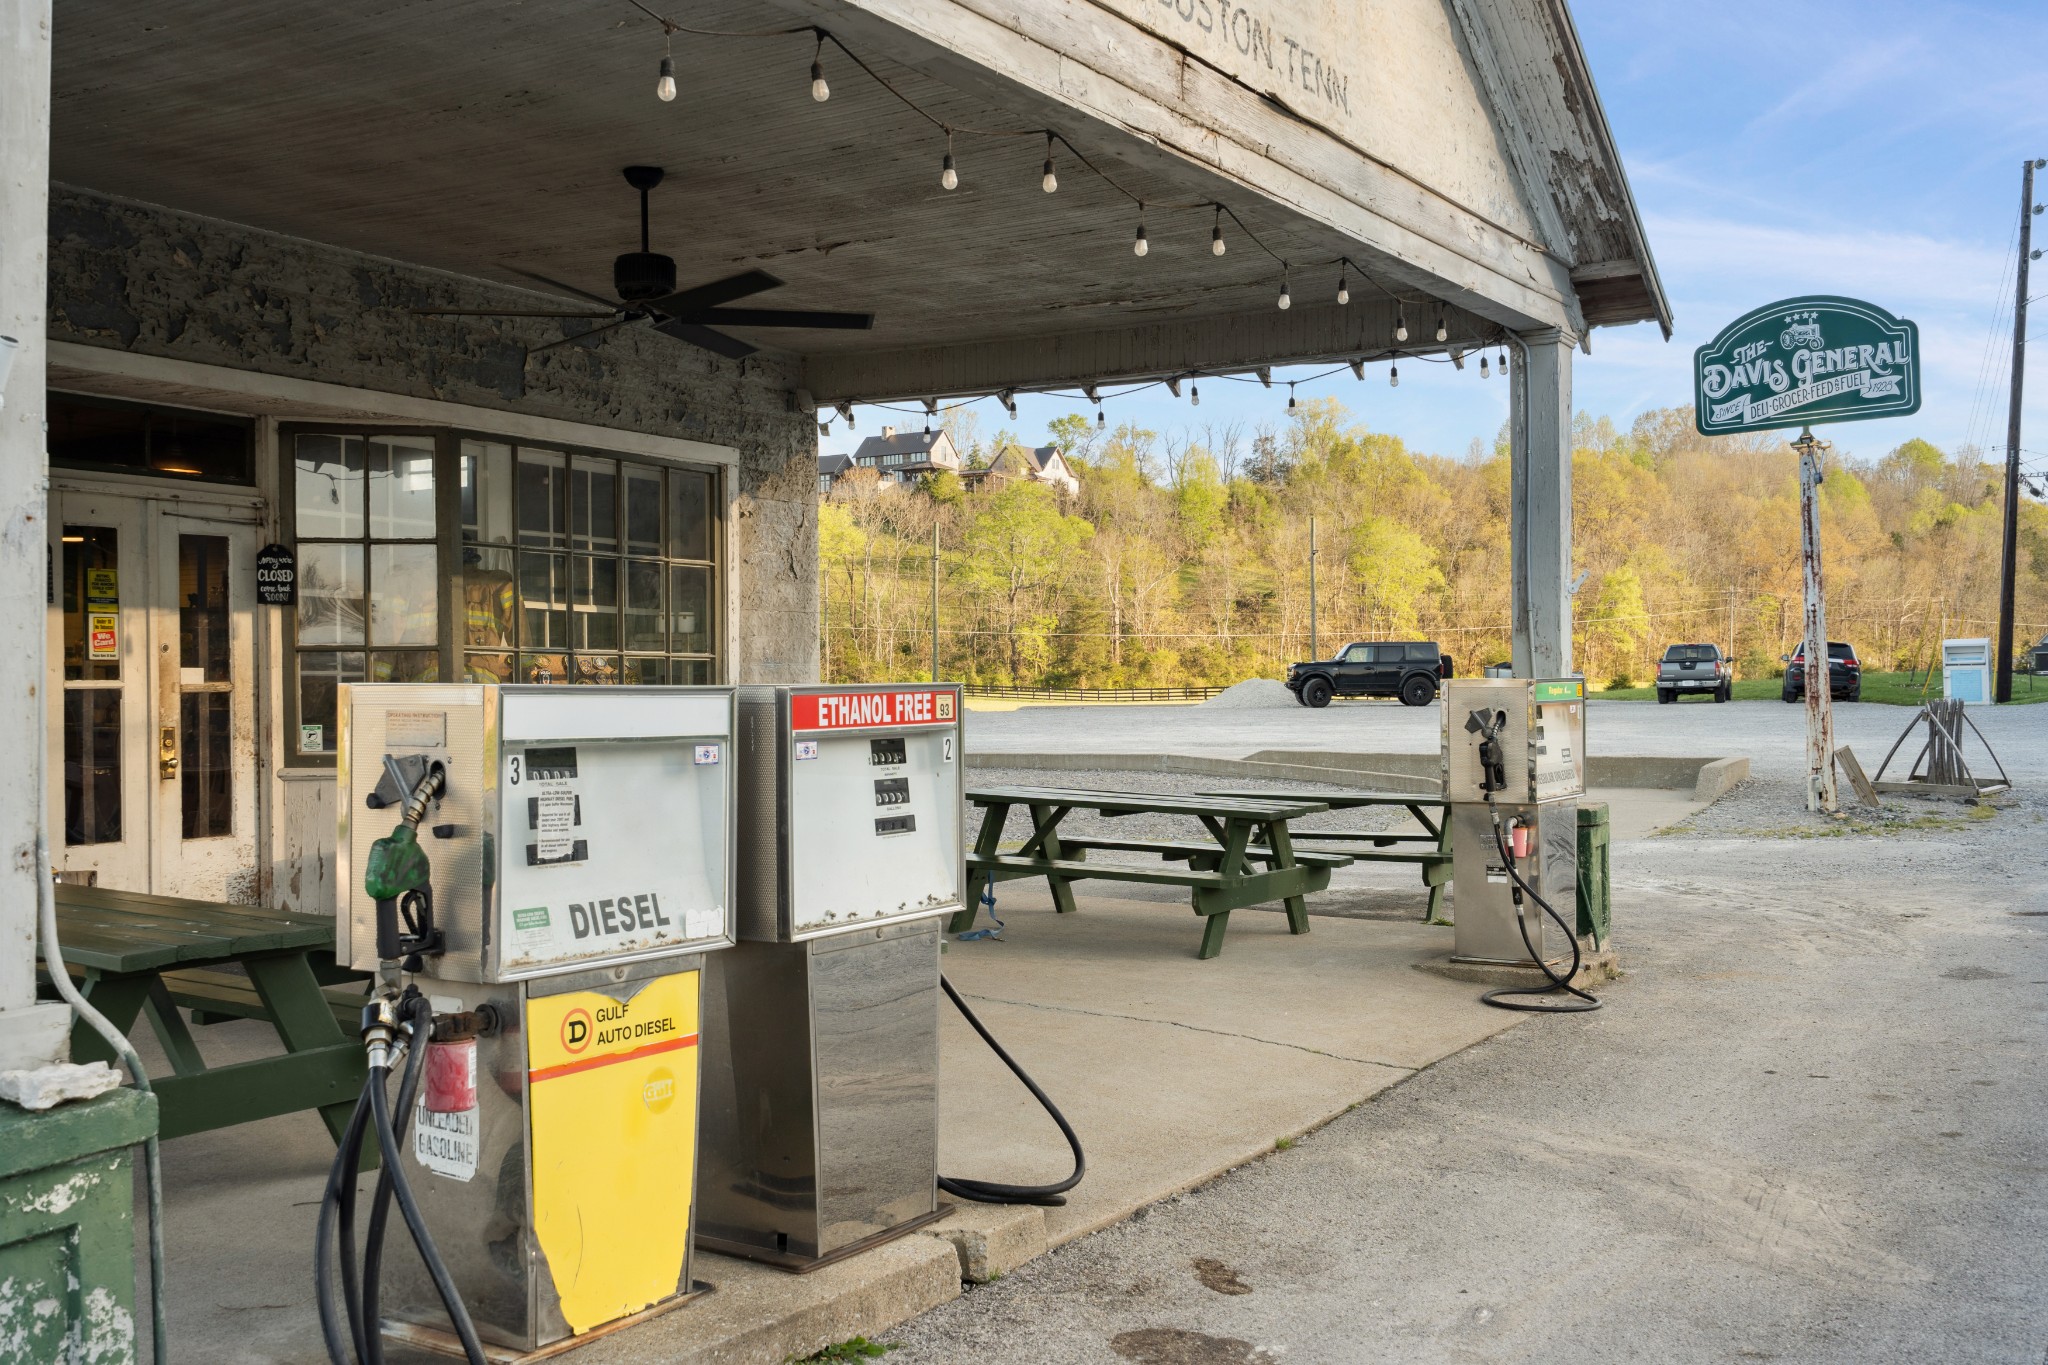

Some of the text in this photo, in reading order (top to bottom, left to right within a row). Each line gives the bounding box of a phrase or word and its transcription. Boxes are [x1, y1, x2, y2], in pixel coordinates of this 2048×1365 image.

[1283, 37, 1352, 118] TENN.
[1730, 340, 1774, 364] THE
[1703, 341, 1910, 399] DAVIS GENERAL
[1840, 372, 1866, 390] FUEL
[1715, 401, 1742, 419] SINCE
[257, 569, 294, 582] CLOSED
[94, 638, 114, 646] Card
[818, 693, 932, 726] ETHANOL FREE
[939, 703, 950, 717] 93
[944, 738, 952, 761] 2
[510, 756, 520, 786] 3
[568, 893, 671, 939] DIESEL
[596, 1004, 629, 1022] GULF
[568, 1020, 587, 1044] D
[597, 1018, 676, 1045] AUTO DIESEL
[418, 1133, 473, 1165] GASOLINE
